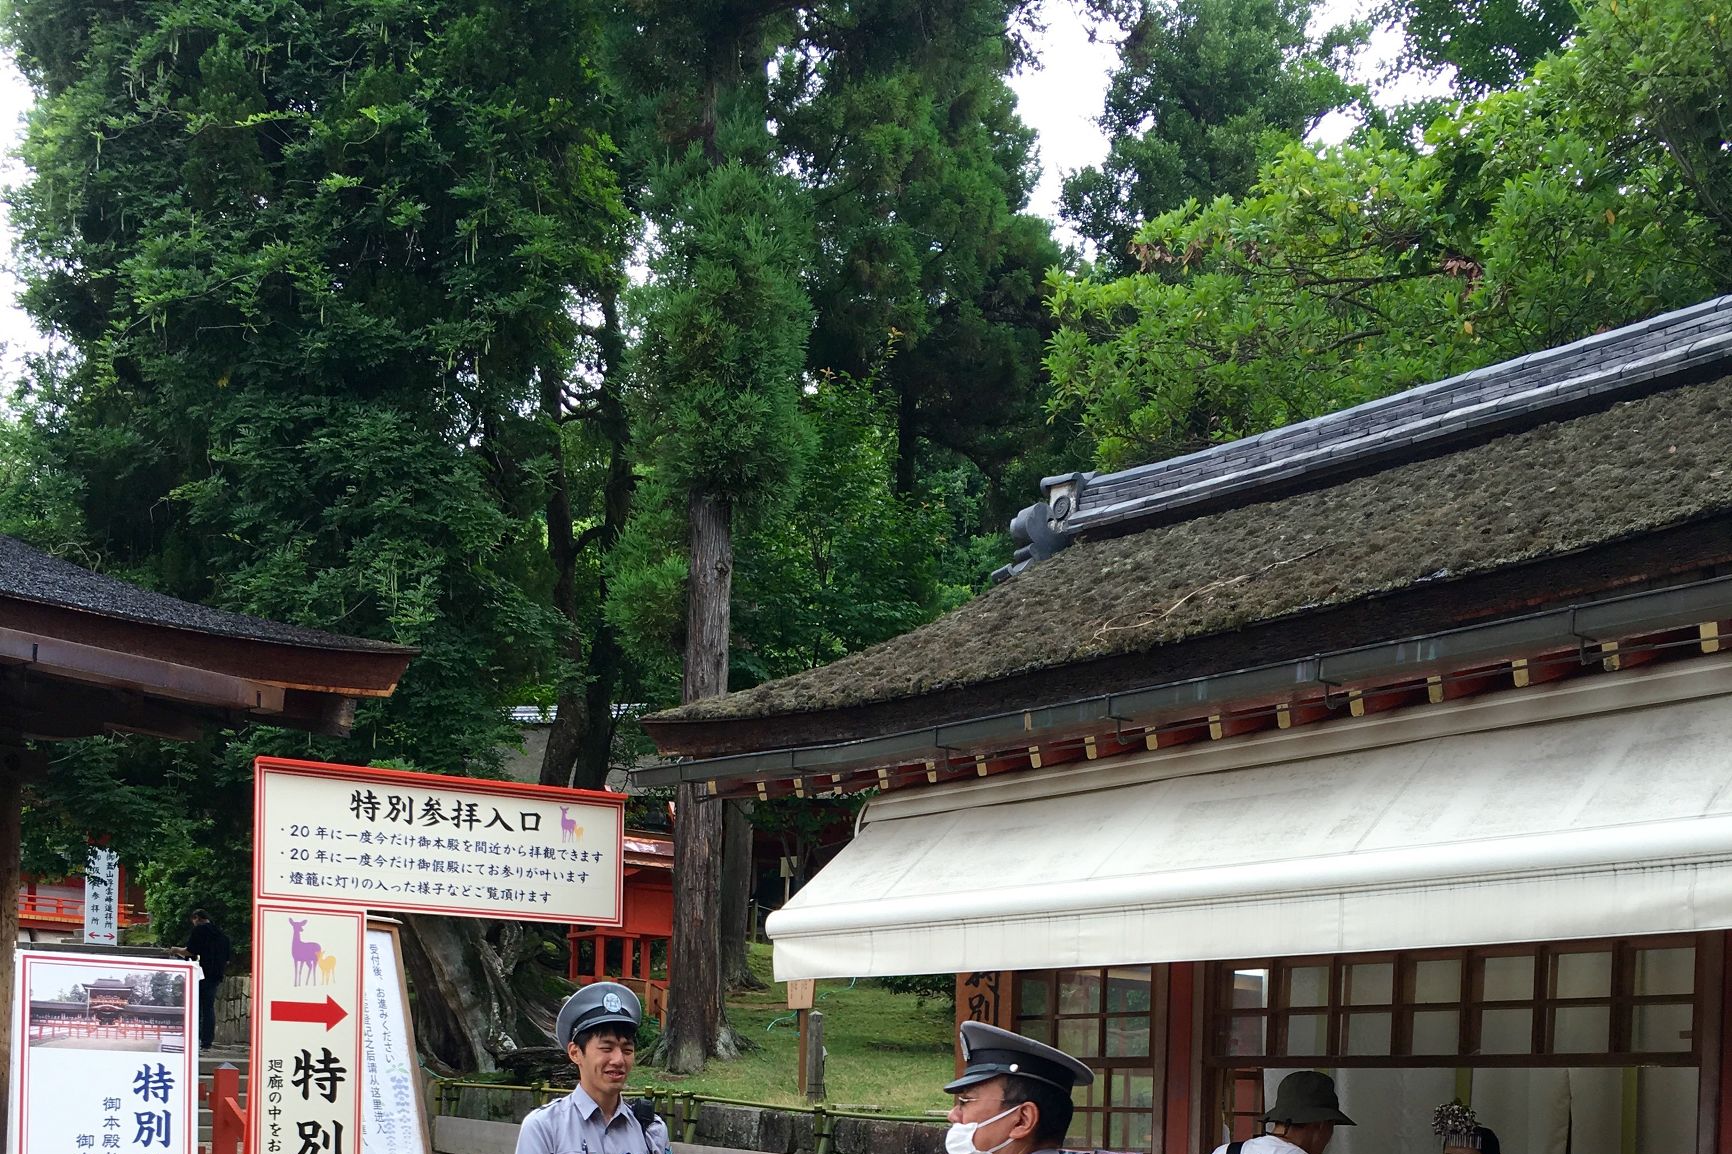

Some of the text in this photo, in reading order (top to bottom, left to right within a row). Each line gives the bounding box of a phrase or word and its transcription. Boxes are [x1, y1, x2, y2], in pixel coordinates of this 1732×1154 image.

[350, 789, 542, 832] 特別参拝入口
